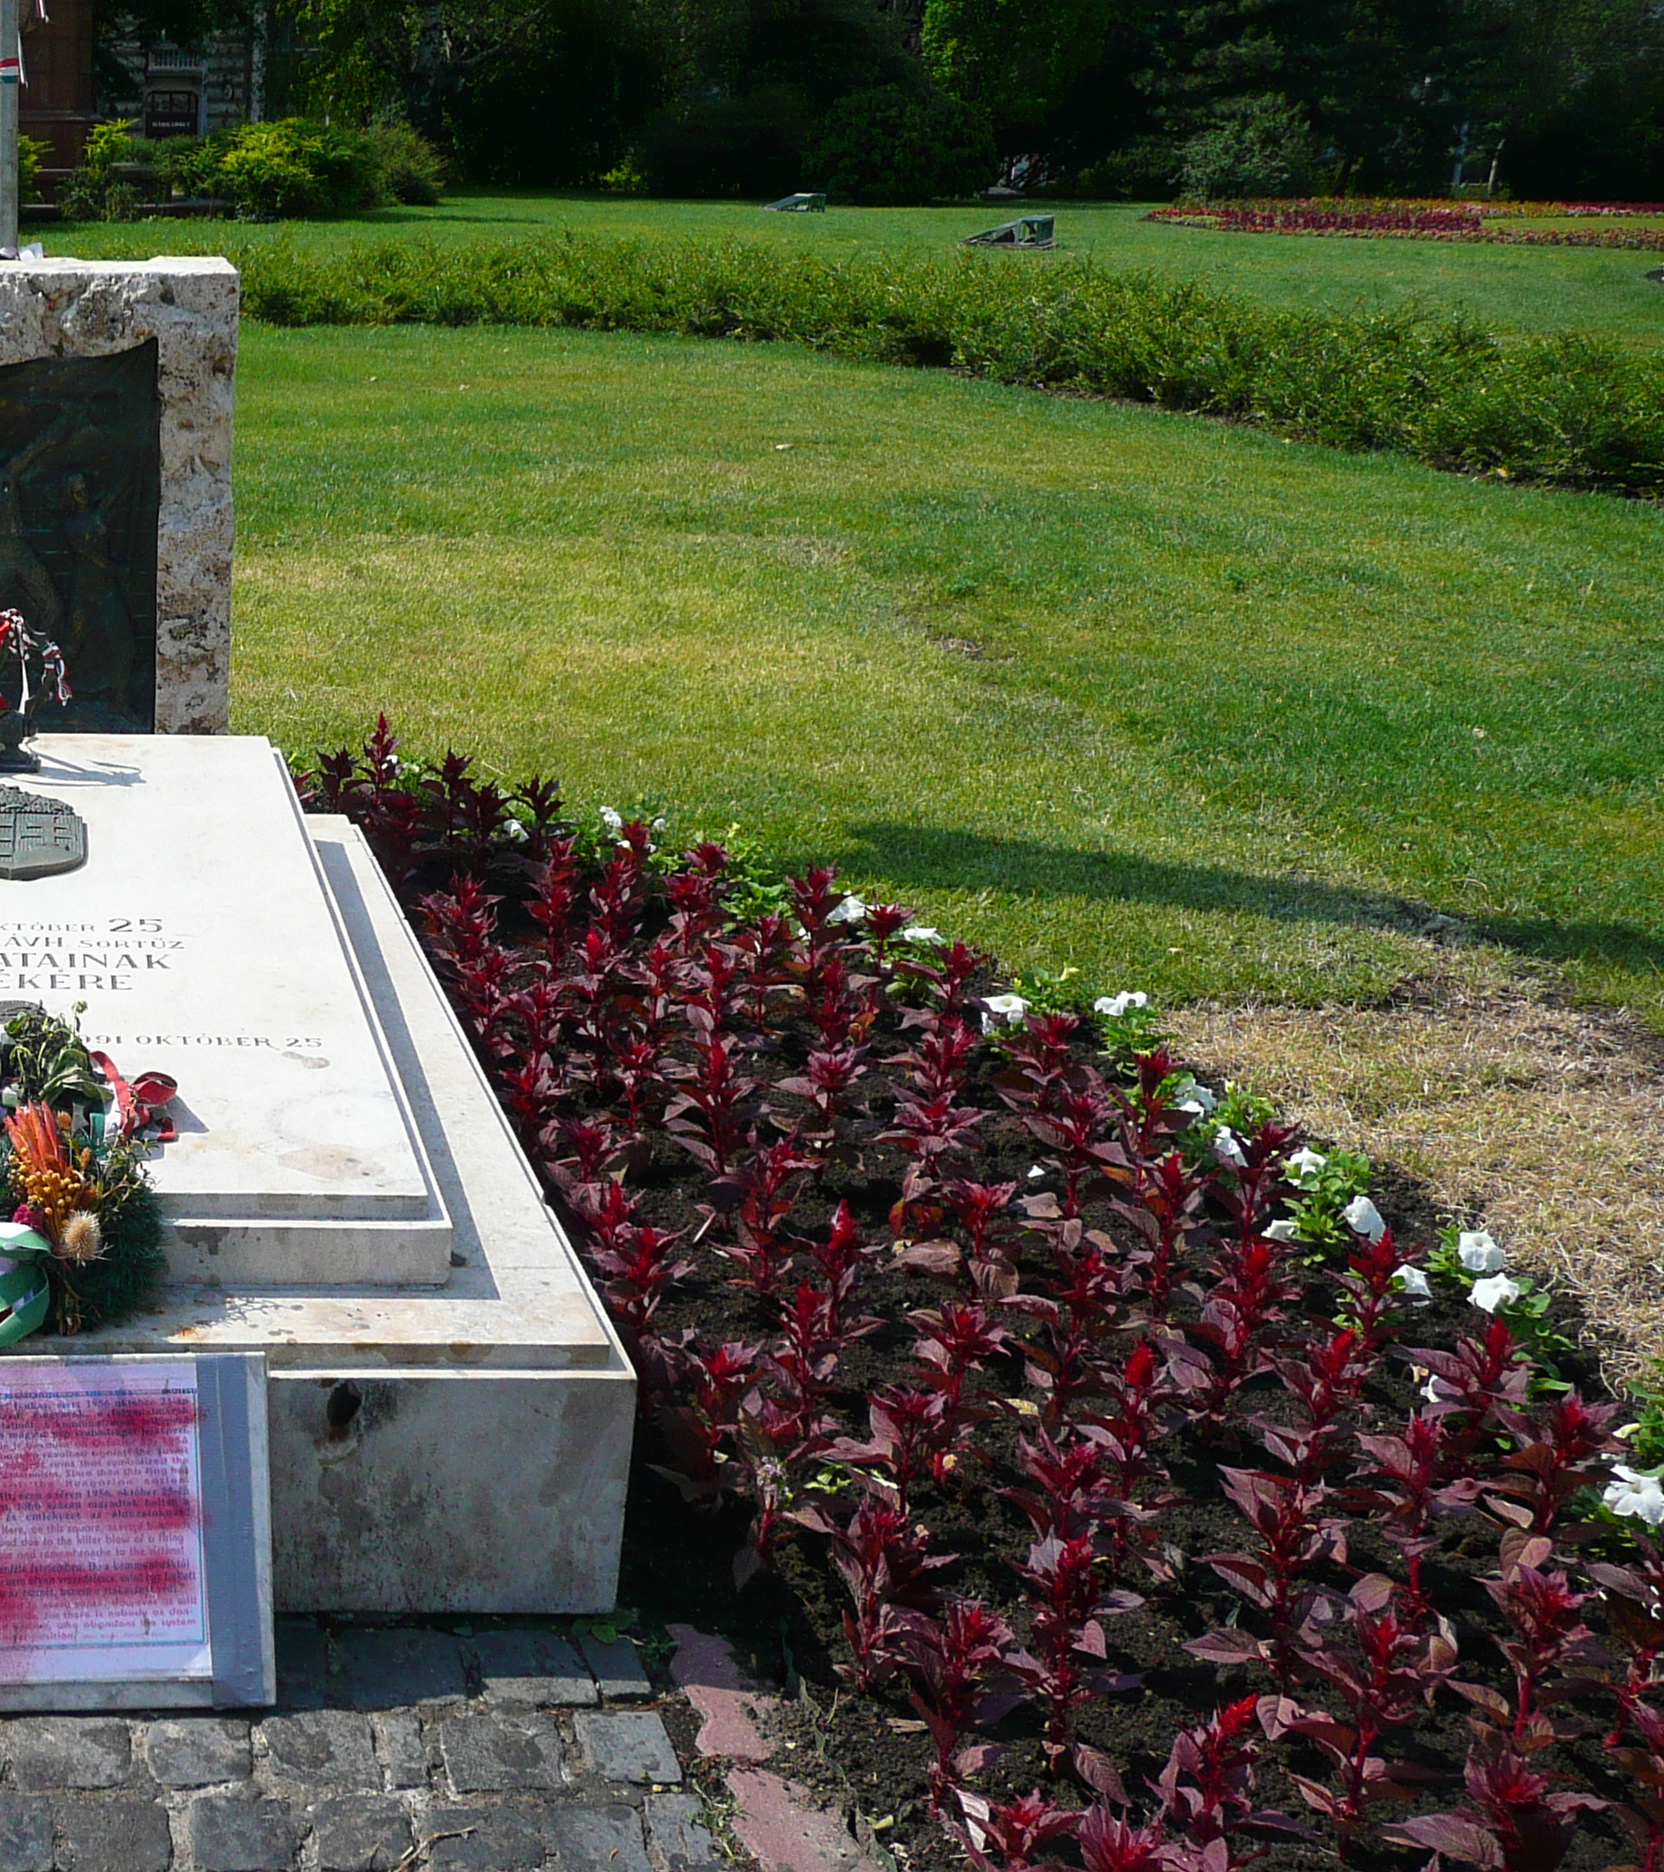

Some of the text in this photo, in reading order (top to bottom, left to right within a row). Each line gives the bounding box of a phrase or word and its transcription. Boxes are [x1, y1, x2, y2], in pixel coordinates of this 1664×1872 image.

[109, 918, 163, 933] 25
[4, 934, 63, 947] ÁVH
[135, 1033, 272, 1047] OKTÓBER
[286, 1037, 323, 1048] 25
